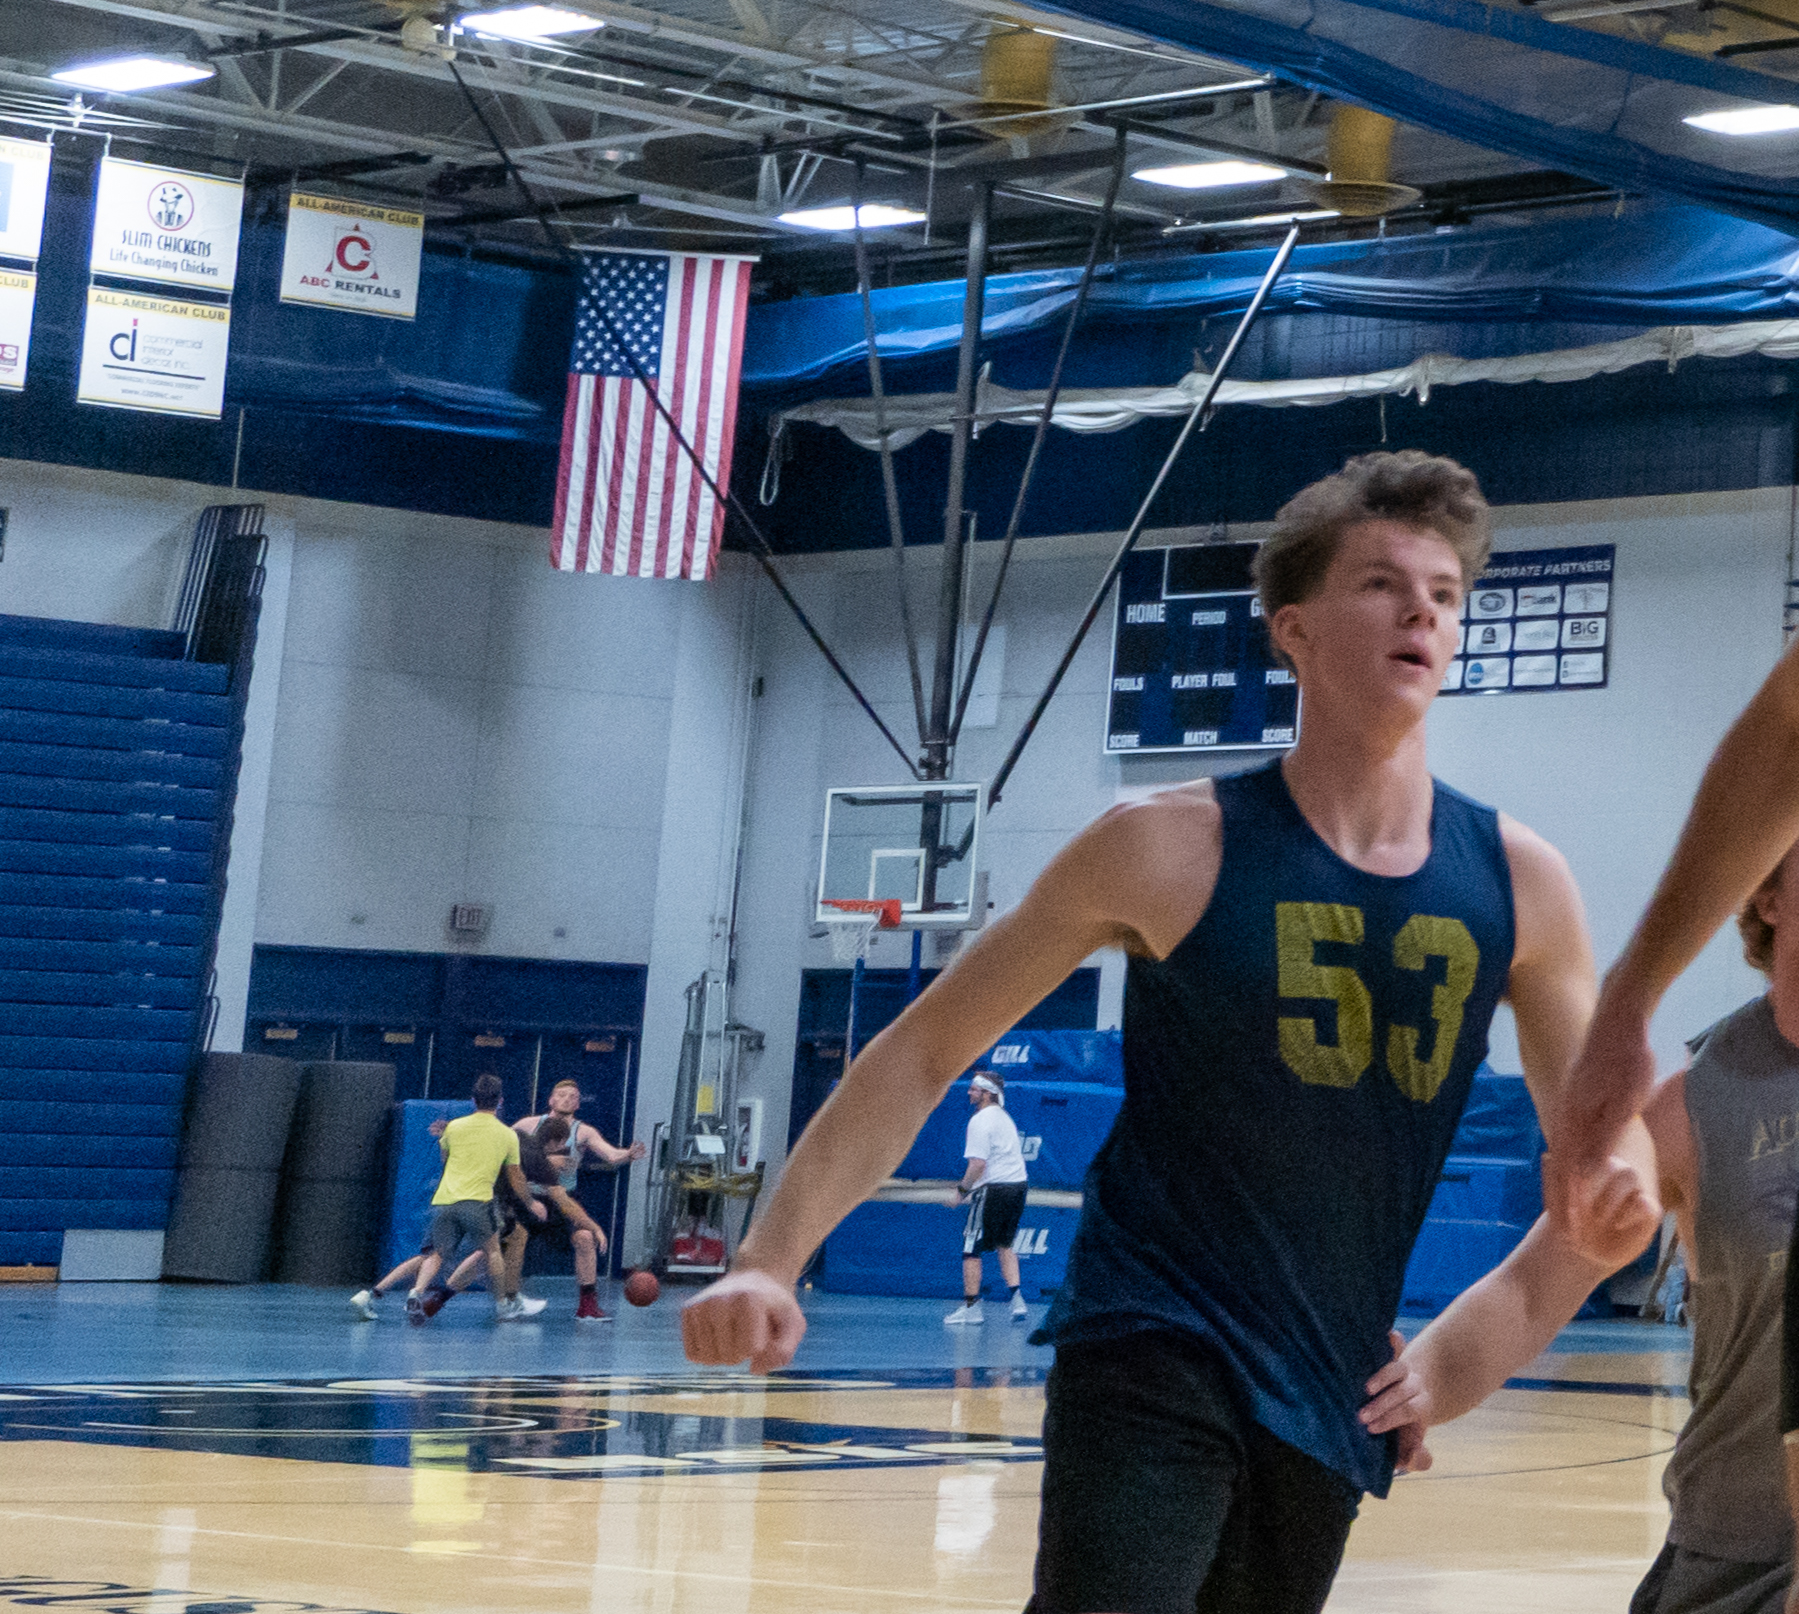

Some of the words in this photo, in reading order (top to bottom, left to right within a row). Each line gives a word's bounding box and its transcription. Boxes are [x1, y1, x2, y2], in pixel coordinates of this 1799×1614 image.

[300, 275, 331, 288] ABC
[335, 280, 401, 299] RENTALS
[192, 308, 226, 321] CLUB
[1126, 603, 1167, 624] HOME
[1113, 676, 1144, 692] FOULS
[1171, 673, 1208, 689] PLAYER
[1211, 671, 1237, 687] FOUL
[1109, 733, 1140, 748] SCORE
[1183, 730, 1218, 745] MATCH
[1262, 727, 1294, 743] SCORE
[1276, 901, 1480, 1103] 53
[1011, 1228, 1050, 1255] ILL
